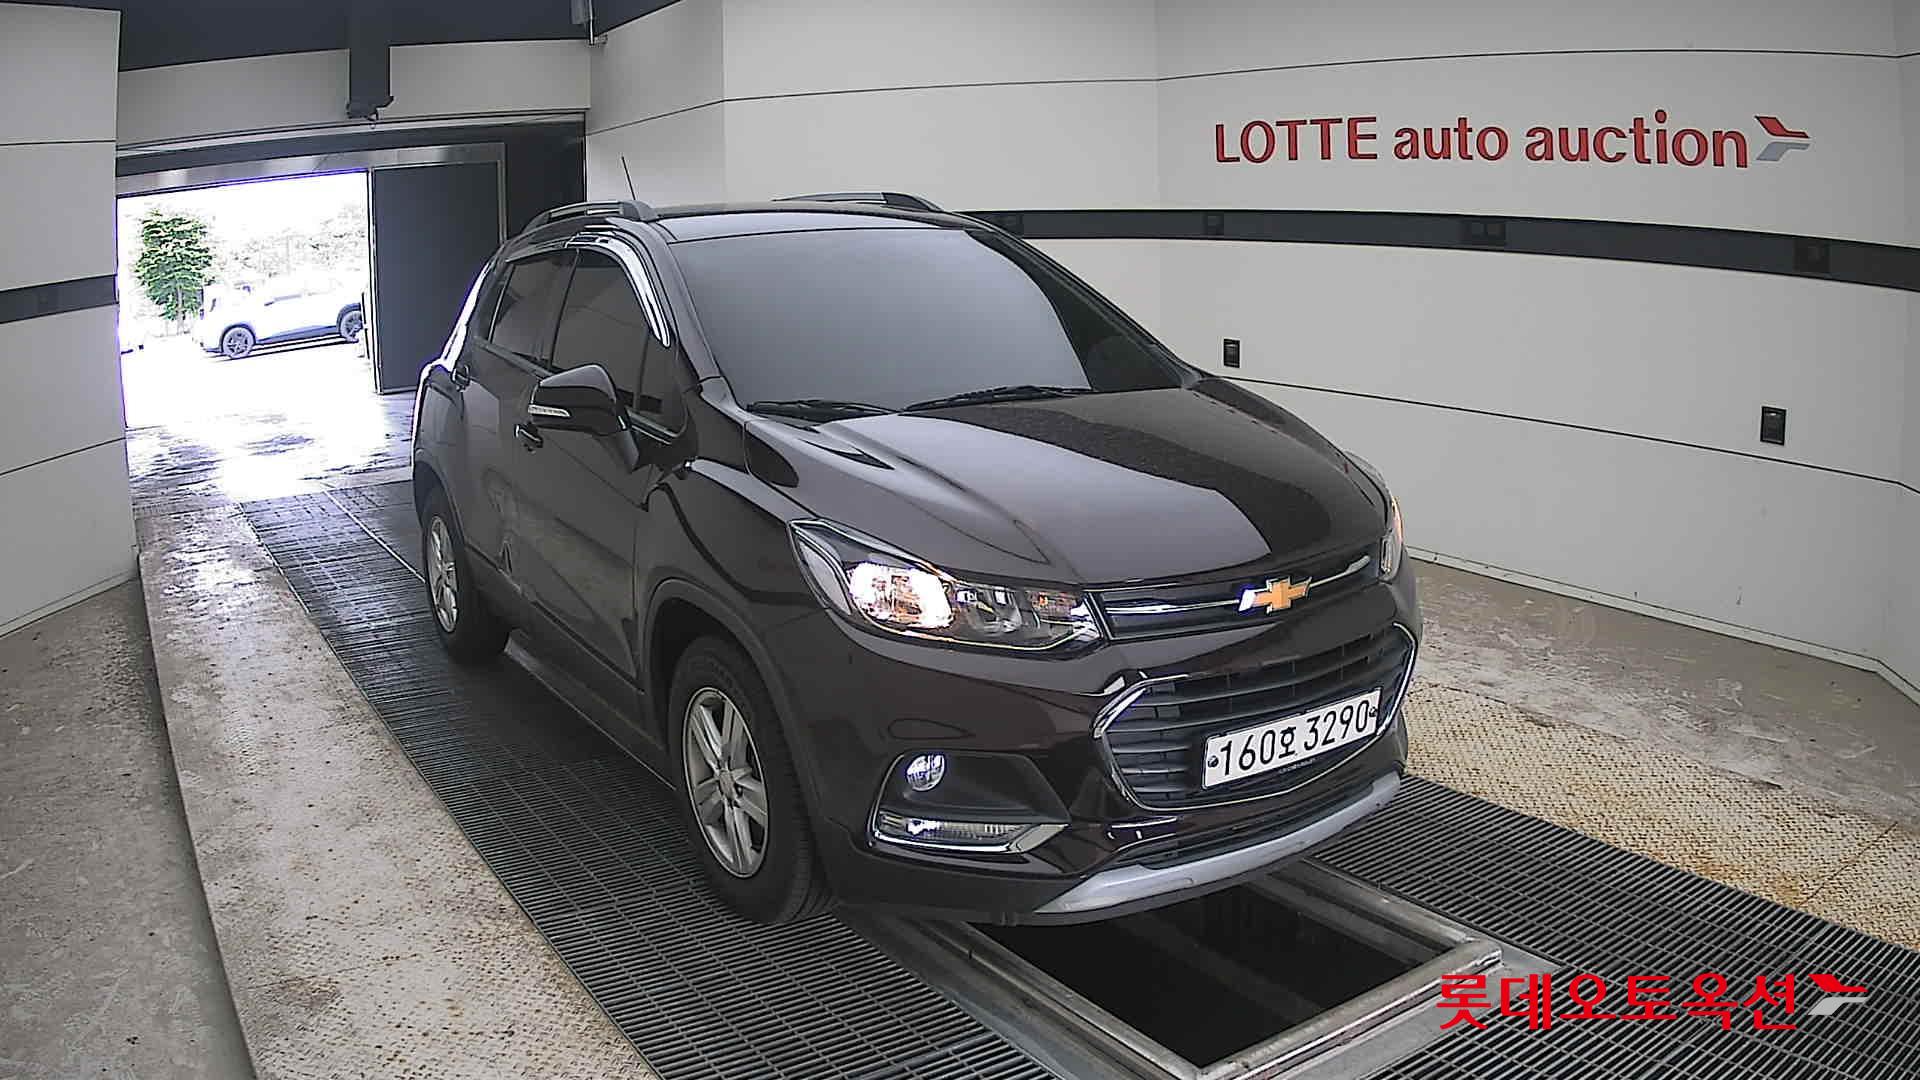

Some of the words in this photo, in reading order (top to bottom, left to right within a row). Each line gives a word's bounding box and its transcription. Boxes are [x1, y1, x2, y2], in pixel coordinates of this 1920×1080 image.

[1215, 116, 1378, 163] LOTTE
[1393, 117, 1509, 161] auto
[1524, 109, 1748, 168] auction
[1220, 726, 1297, 776] 160호
[1303, 700, 1370, 751] 3290
